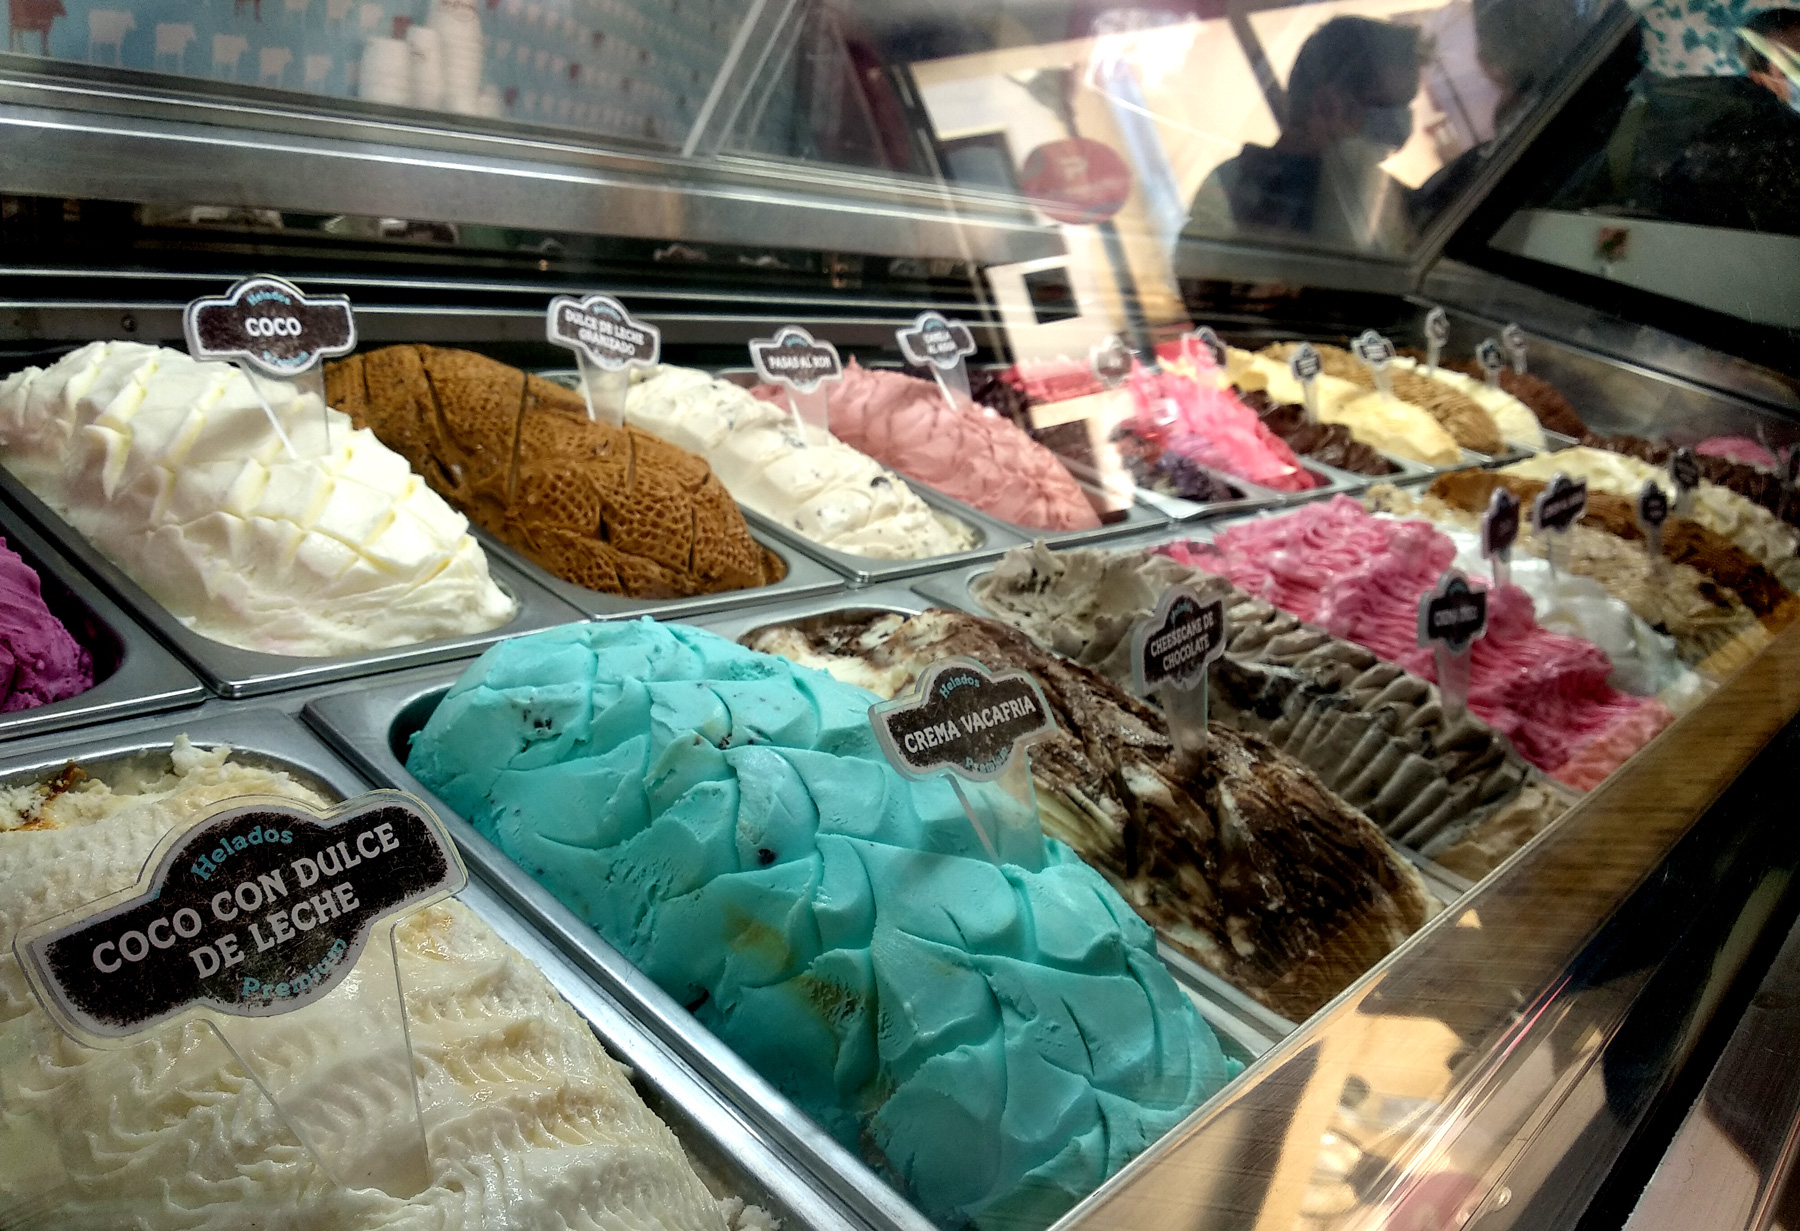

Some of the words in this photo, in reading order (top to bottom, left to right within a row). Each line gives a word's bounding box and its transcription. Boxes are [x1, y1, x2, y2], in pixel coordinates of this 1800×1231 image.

[245, 316, 302, 337] COCO
[565, 308, 598, 331] DULCE
[598, 319, 614, 335] DE
[614, 324, 645, 346] LECHE
[578, 327, 636, 356] GRANIZADO
[767, 355, 800, 370] PASAS
[800, 353, 813, 370] AL
[1150, 617, 1203, 658] CHEESECAKE
[1202, 610, 1214, 630] DE
[1162, 632, 1211, 671] CHOCOLATE
[939, 673, 981, 699] Helados
[904, 719, 962, 754] CREMA
[960, 695, 1037, 735] VACAFRIA
[965, 747, 1008, 774] Premium
[191, 825, 293, 880] Helados
[92, 907, 202, 974] COCO
[211, 869, 290, 921] CON
[290, 823, 400, 887] DULCE
[188, 934, 245, 979] DE
[247, 882, 360, 950] LECHE
[241, 938, 348, 999] Premium
